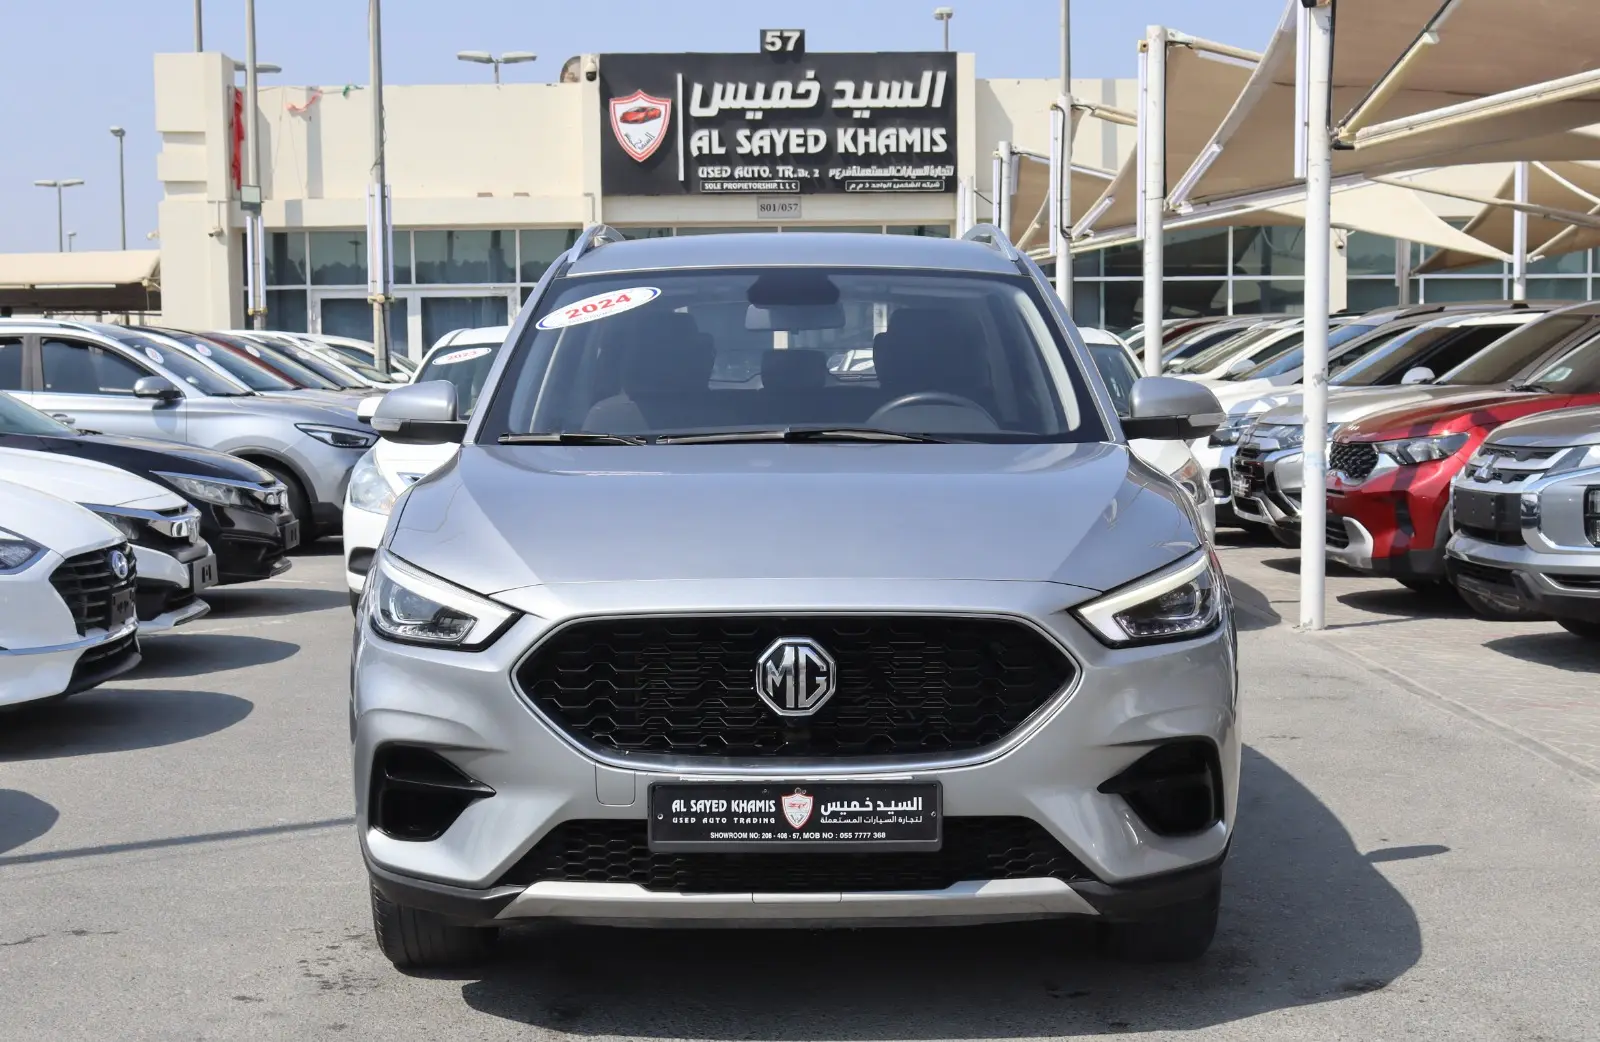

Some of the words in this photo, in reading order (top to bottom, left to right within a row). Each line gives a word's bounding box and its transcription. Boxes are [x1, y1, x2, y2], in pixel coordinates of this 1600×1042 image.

[765, 31, 801, 51] 57
[689, 69, 820, 120] خميس
[831, 69, 947, 119] السيد
[690, 128, 726, 157] AL
[736, 128, 827, 157] SAYED
[837, 128, 948, 157] KHAMIS
[698, 166, 731, 178] USED
[734, 166, 772, 179] AUTO.
[704, 182, 722, 190] SOLE
[759, 202, 799, 212] 801/057
[565, 293, 632, 319] 2024
[766, 646, 828, 708] MG
[672, 799, 686, 813] AL
[690, 799, 727, 813] SAYED
[731, 799, 776, 814] KHAMIS
[820, 797, 873, 815] خميس
[877, 796, 922, 814] السيد
[820, 816, 862, 824] المستعملة
[864, 816, 897, 824] السيارات
